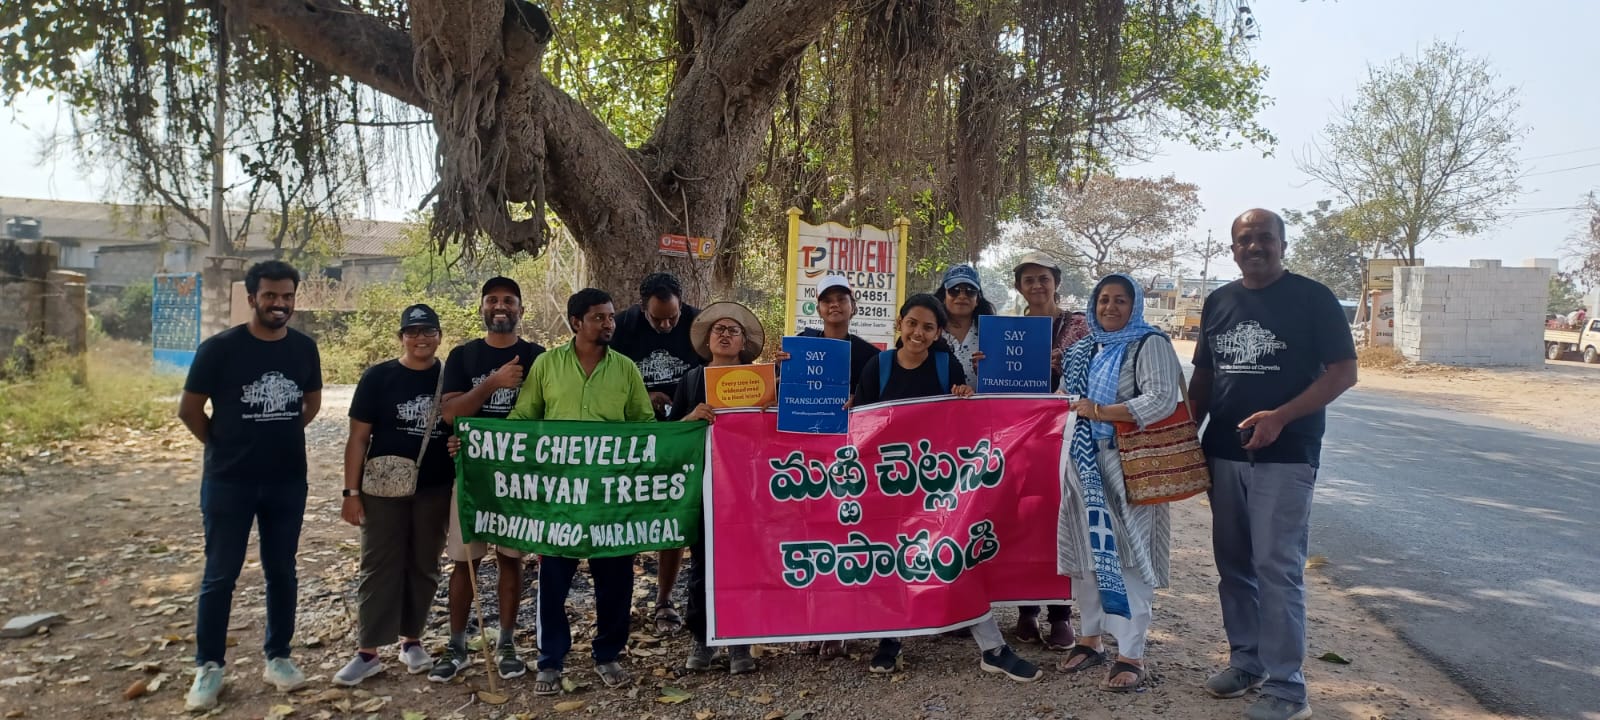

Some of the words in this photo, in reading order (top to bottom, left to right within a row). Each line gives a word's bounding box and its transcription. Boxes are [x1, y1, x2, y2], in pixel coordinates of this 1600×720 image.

[827, 237, 893, 273] TRIVENI
[804, 288, 817, 298] MO
[1004, 330, 1026, 341] SAY
[806, 351, 826, 361] SAY
[1006, 346, 1023, 356] NO
[807, 365, 824, 375] NO
[1006, 361, 1022, 371] TO
[807, 380, 822, 390] TO
[982, 377, 1048, 388] TRANSLOCATION
[785, 397, 846, 405] TRANSLOCATION
[458, 422, 528, 463] “SAVE
[535, 434, 657, 466] CHEVELLA
[875, 438, 1005, 512] చెట్లను
[494, 471, 589, 505] BANYAN
[601, 464, 695, 504] TREES”
[475, 510, 544, 543] MEDHINI
[547, 518, 685, 547] NGO-WARANGAL
[779, 519, 1001, 589] కాపాడండి
